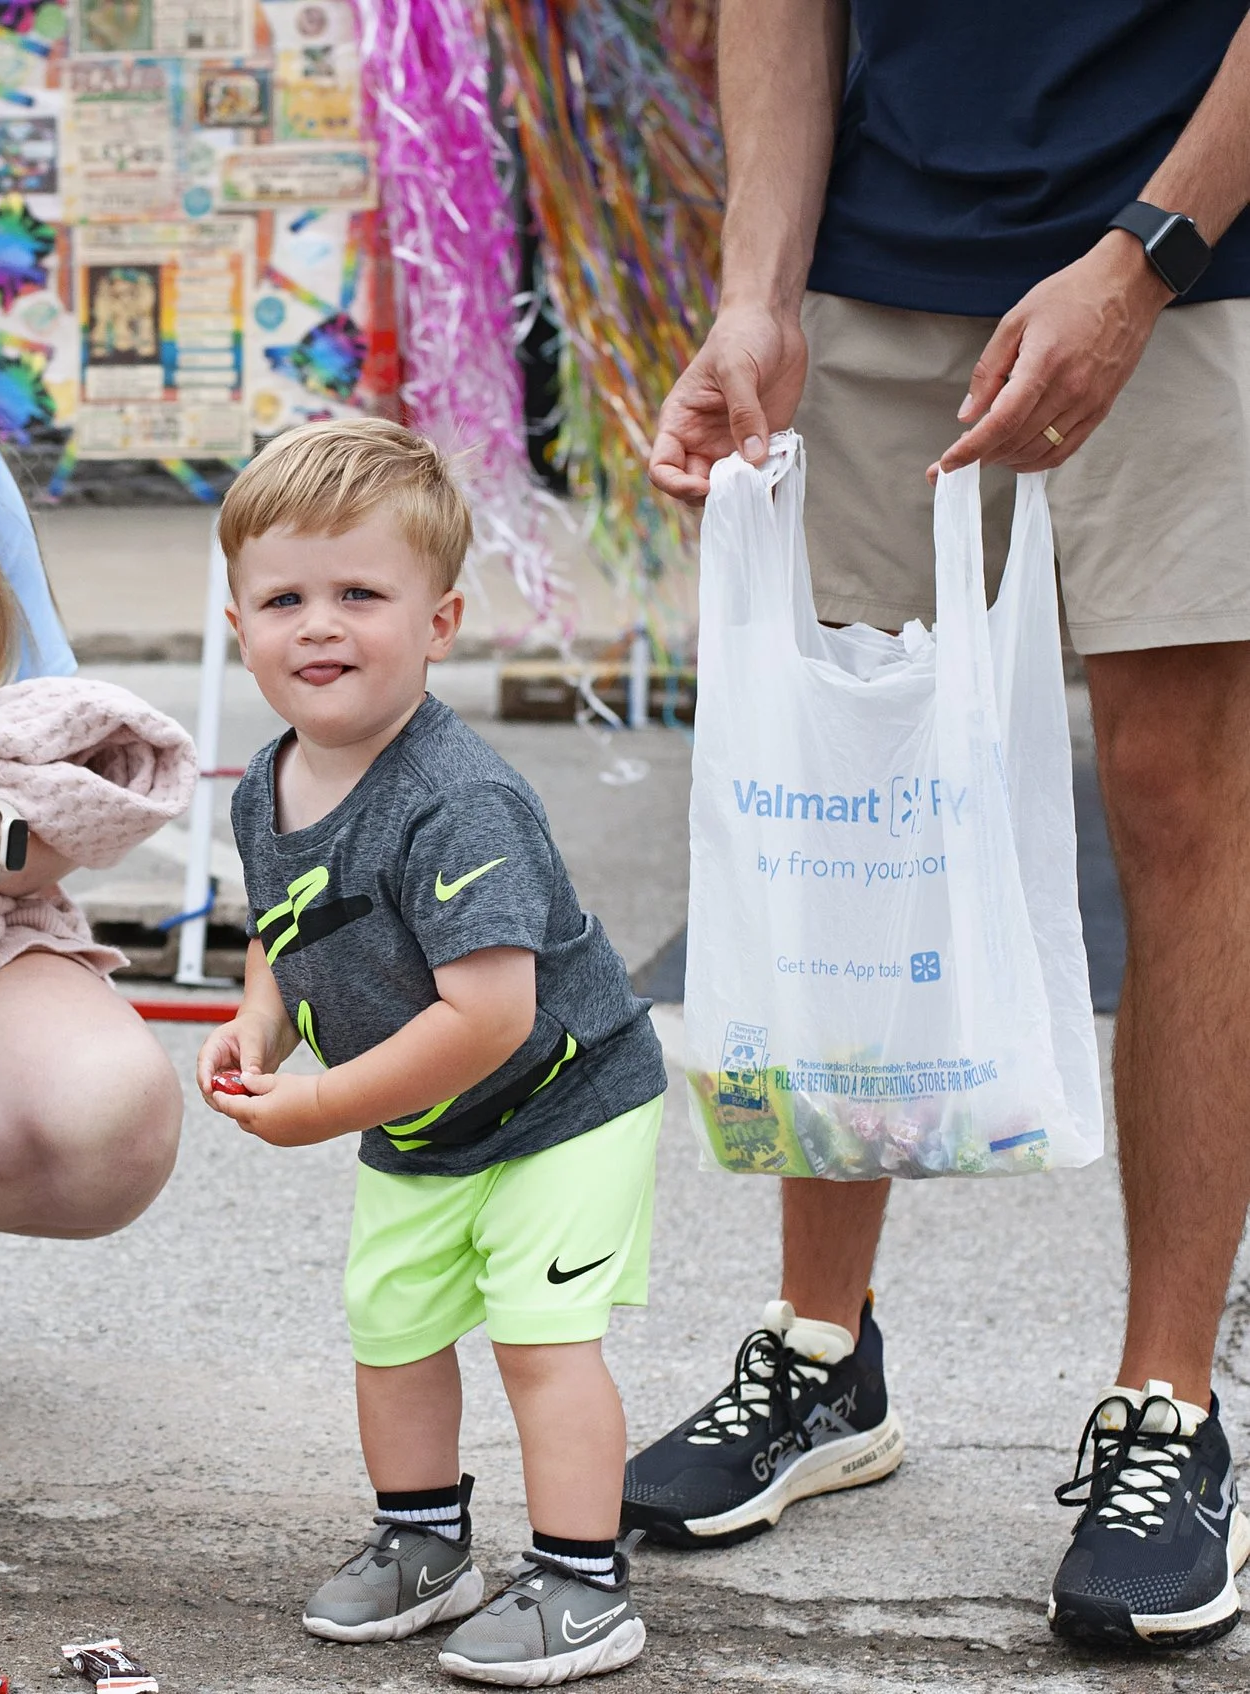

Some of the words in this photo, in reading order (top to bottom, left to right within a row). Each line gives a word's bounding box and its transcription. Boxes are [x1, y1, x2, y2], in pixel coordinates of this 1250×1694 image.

[788, 850, 855, 879] from
[777, 955, 805, 974] Get
[811, 958, 838, 976] the
[843, 960, 875, 982] App
[879, 961, 903, 978] toda
[796, 1058, 821, 1070] Please
[775, 1071, 805, 1091] PLEASE
[807, 1072, 838, 1093] RETURN
[839, 1074, 850, 1094] TO
[851, 1075, 857, 1095] A
[918, 1071, 946, 1093] STORE
[947, 1070, 962, 1091] FOR
